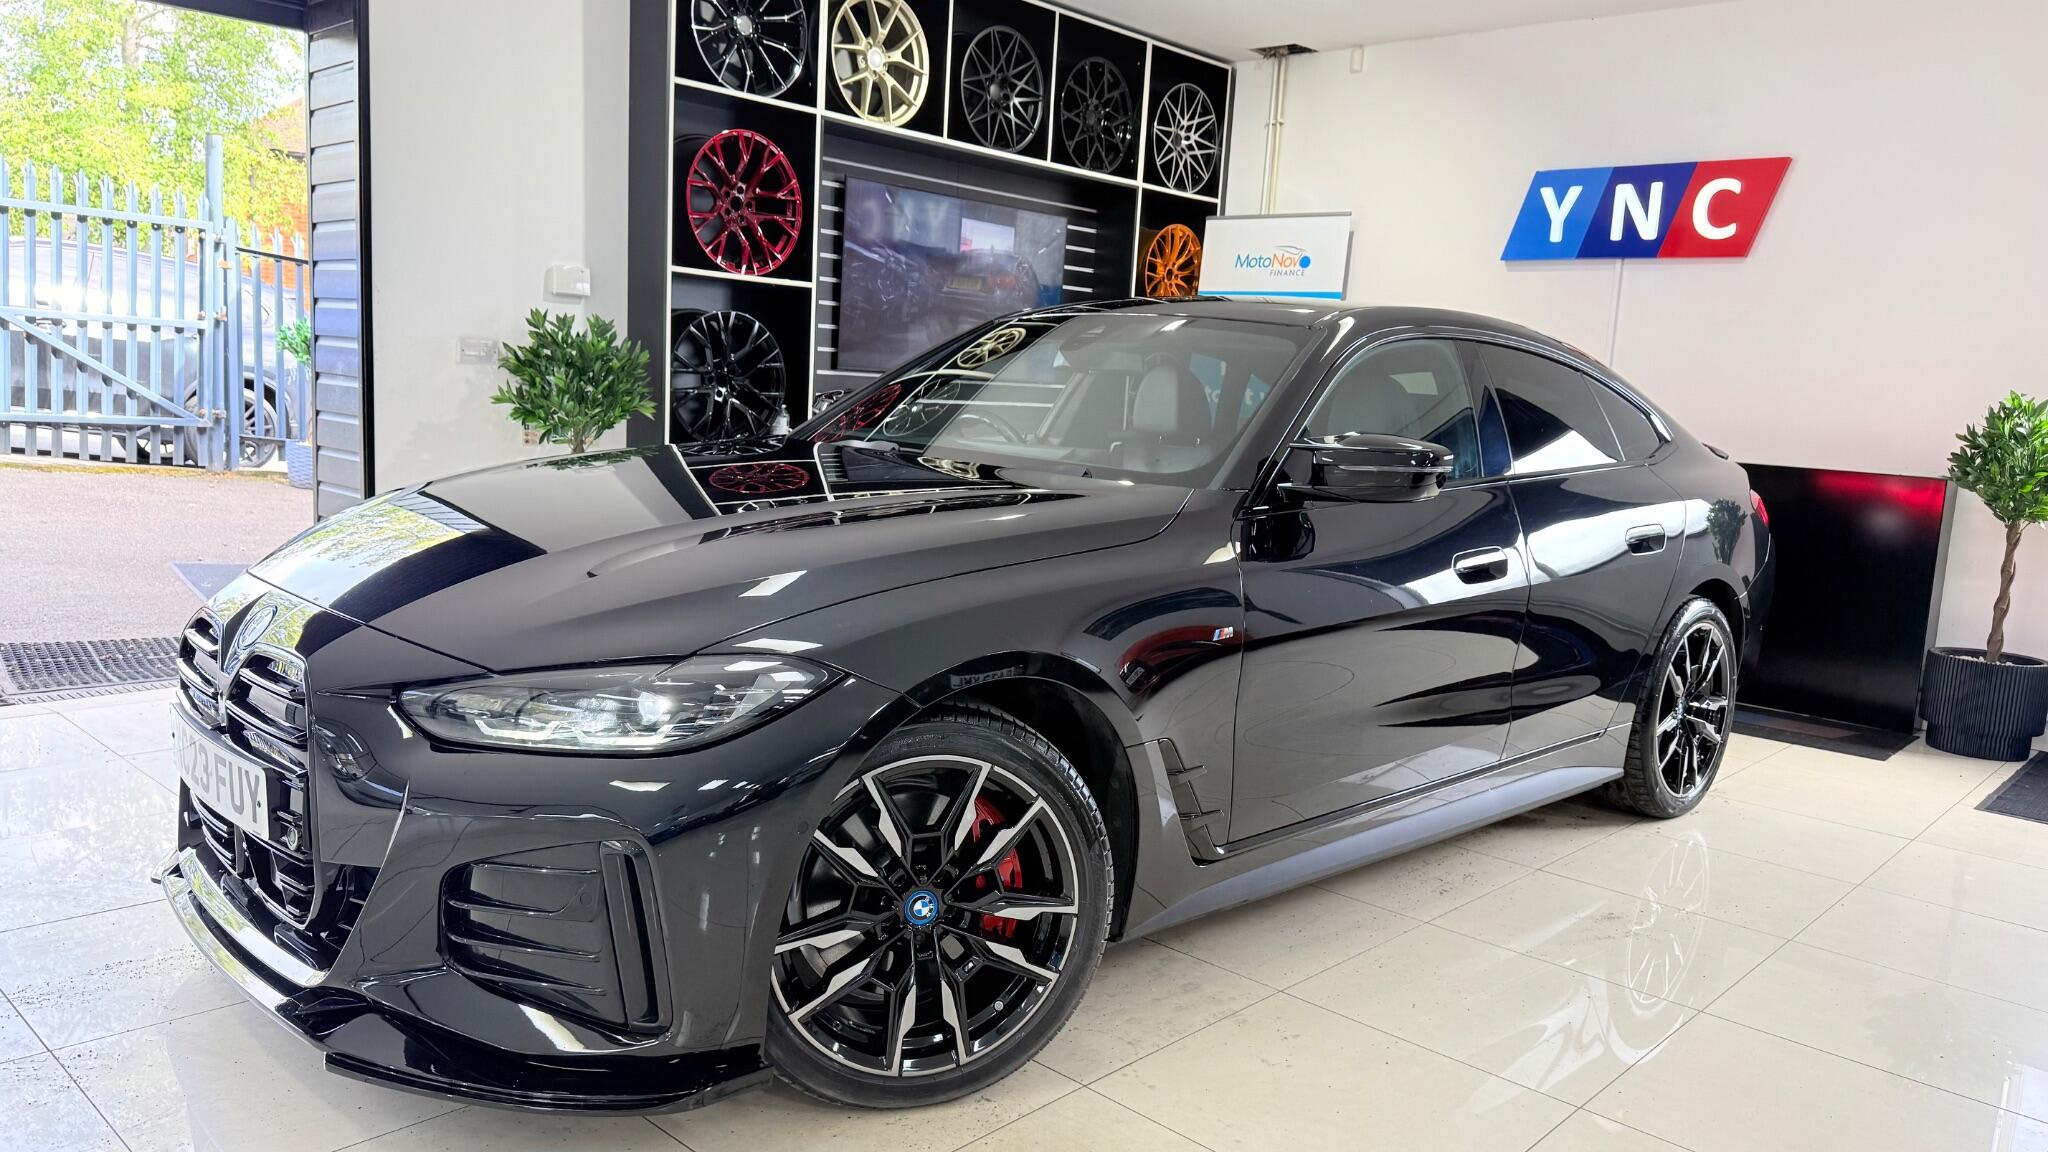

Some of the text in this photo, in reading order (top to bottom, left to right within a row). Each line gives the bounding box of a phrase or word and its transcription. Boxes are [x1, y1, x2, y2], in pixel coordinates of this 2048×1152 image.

[1540, 177, 1742, 243] YNC
[1269, 269, 1306, 277] FINANCE
[214, 753, 260, 825] FUY
